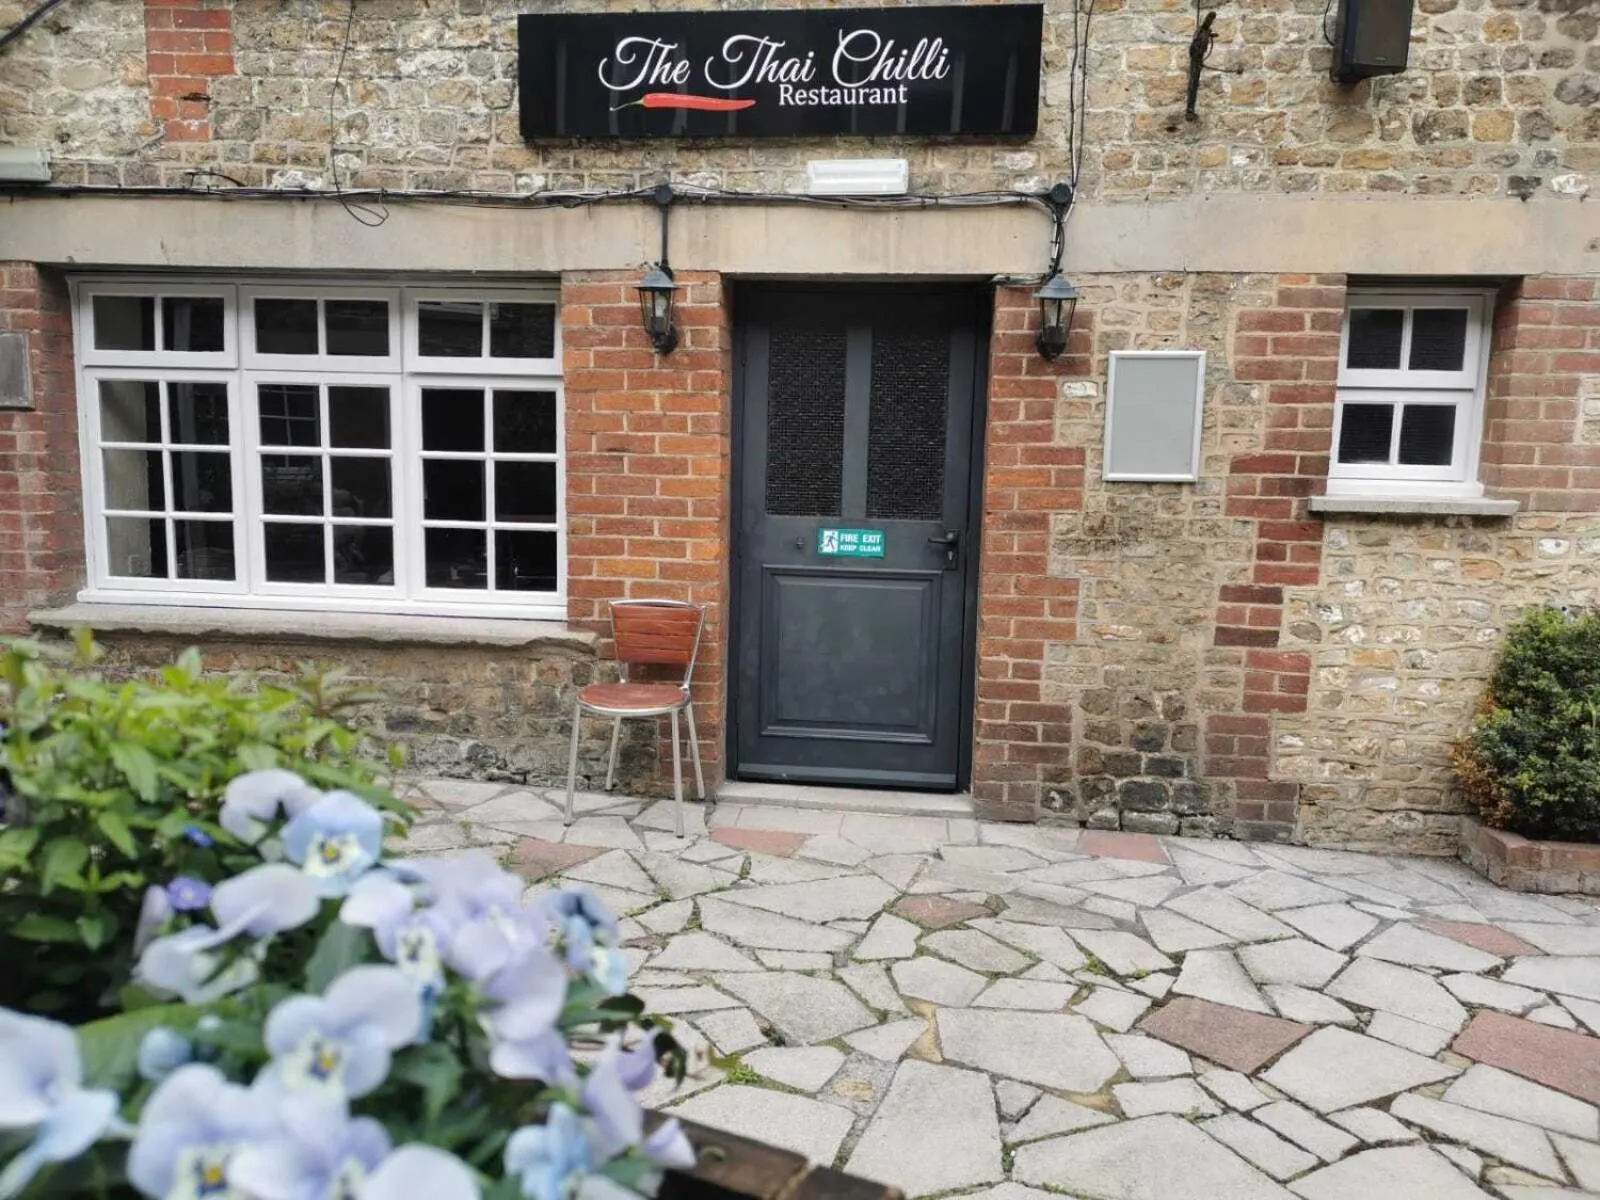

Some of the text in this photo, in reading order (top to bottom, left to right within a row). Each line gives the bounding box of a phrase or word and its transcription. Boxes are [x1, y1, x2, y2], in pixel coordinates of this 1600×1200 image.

[599, 28, 951, 91] The Thai Chilli
[778, 83, 908, 107] Restaurant
[840, 533, 882, 544] FIRE EXIT
